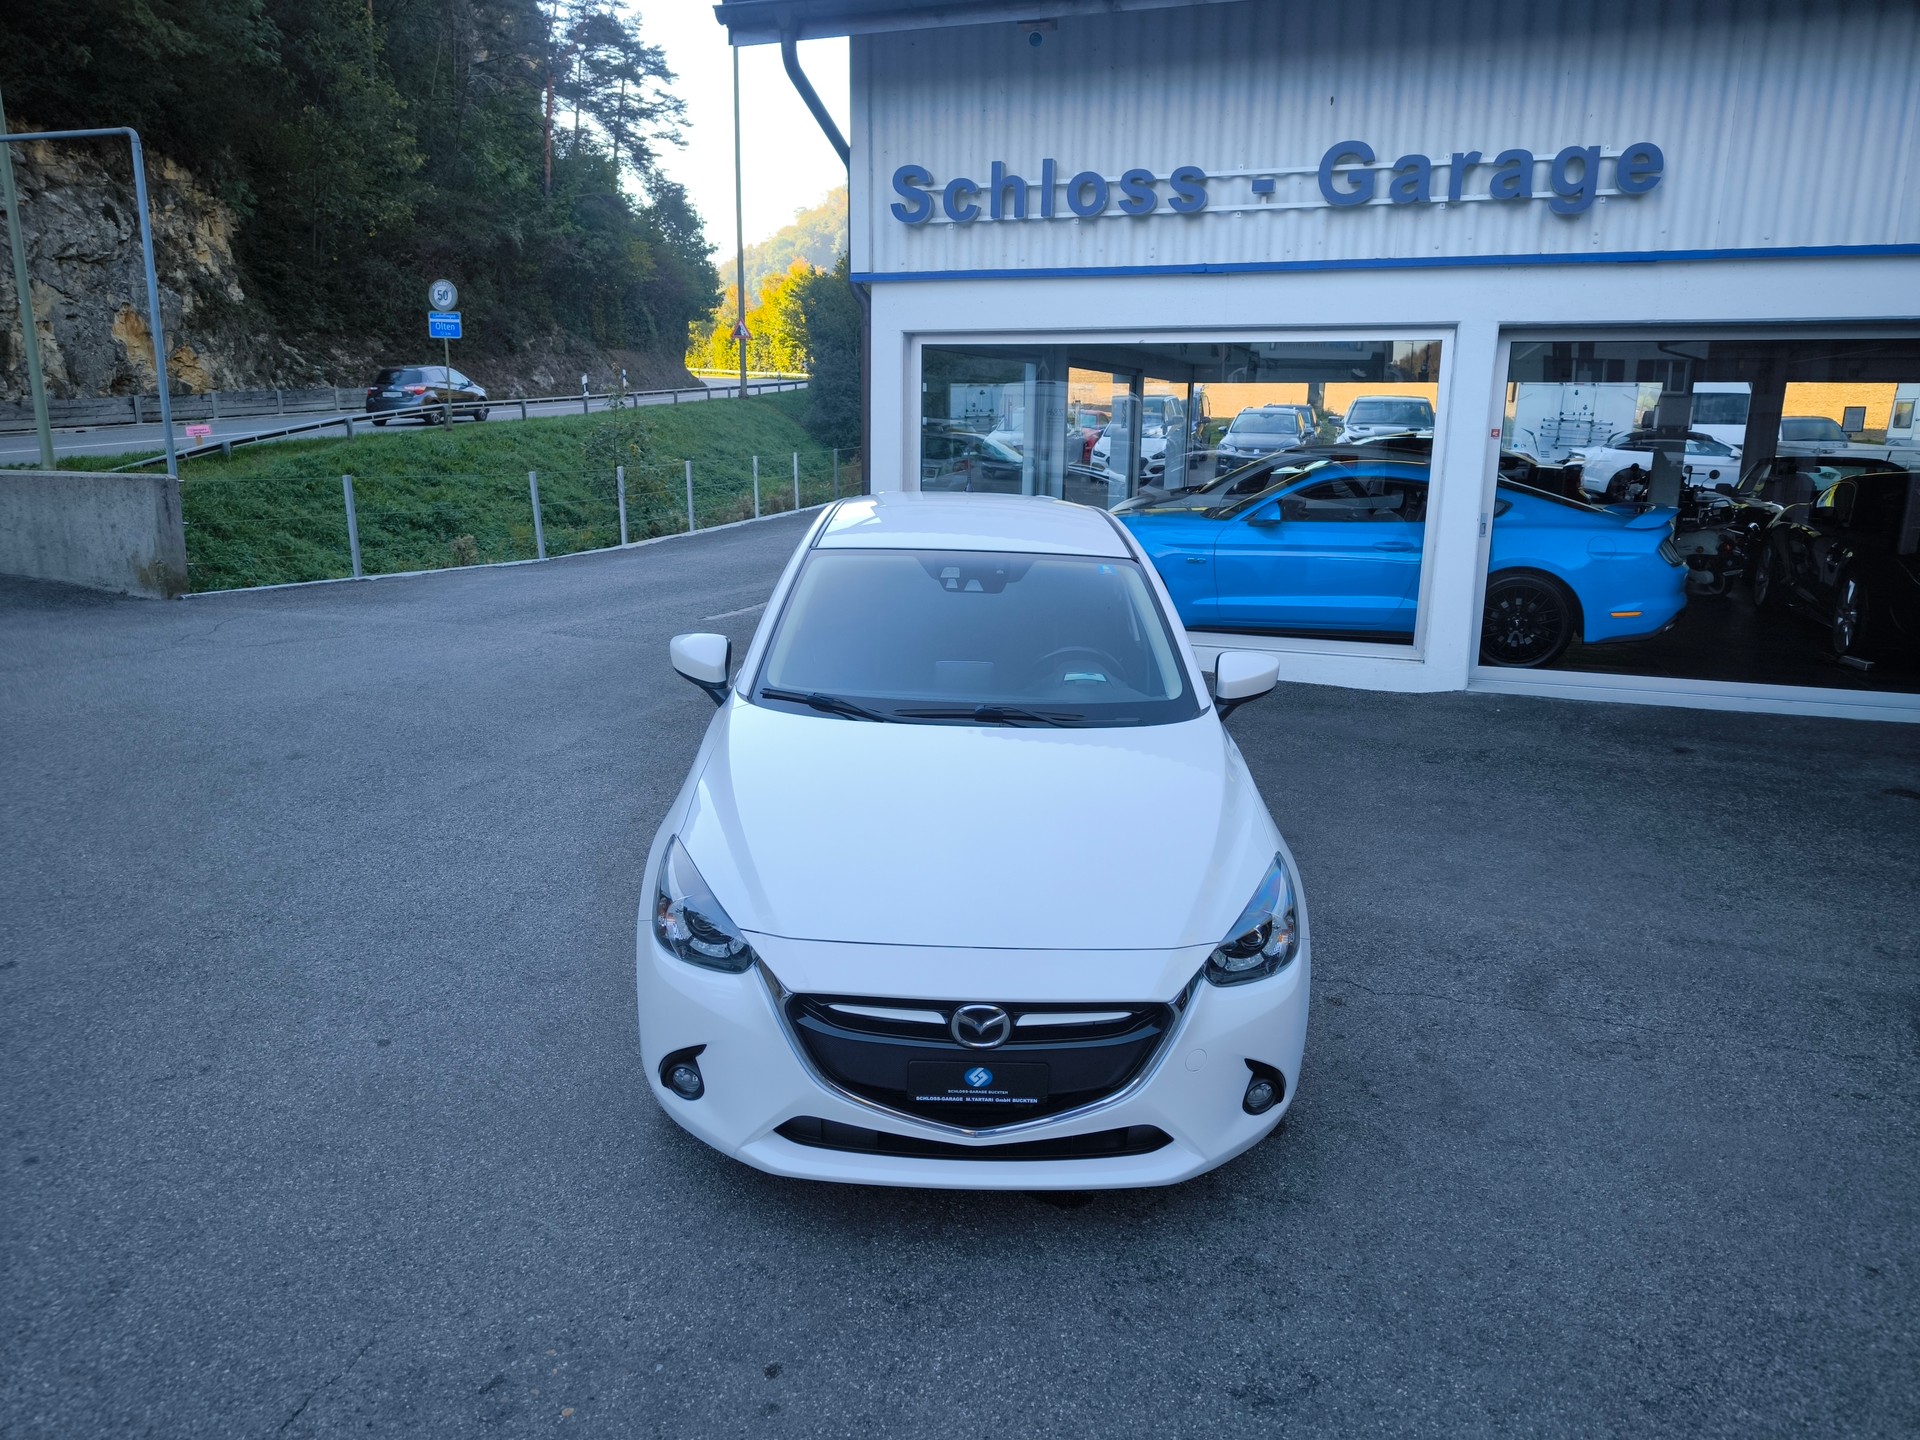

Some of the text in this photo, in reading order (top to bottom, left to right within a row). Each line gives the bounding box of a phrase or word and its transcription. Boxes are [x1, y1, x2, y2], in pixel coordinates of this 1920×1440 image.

[890, 157, 1208, 226] Schloss
[1317, 140, 1665, 218] Garage
[437, 290, 448, 300] 50
[435, 322, 456, 331] Olten
